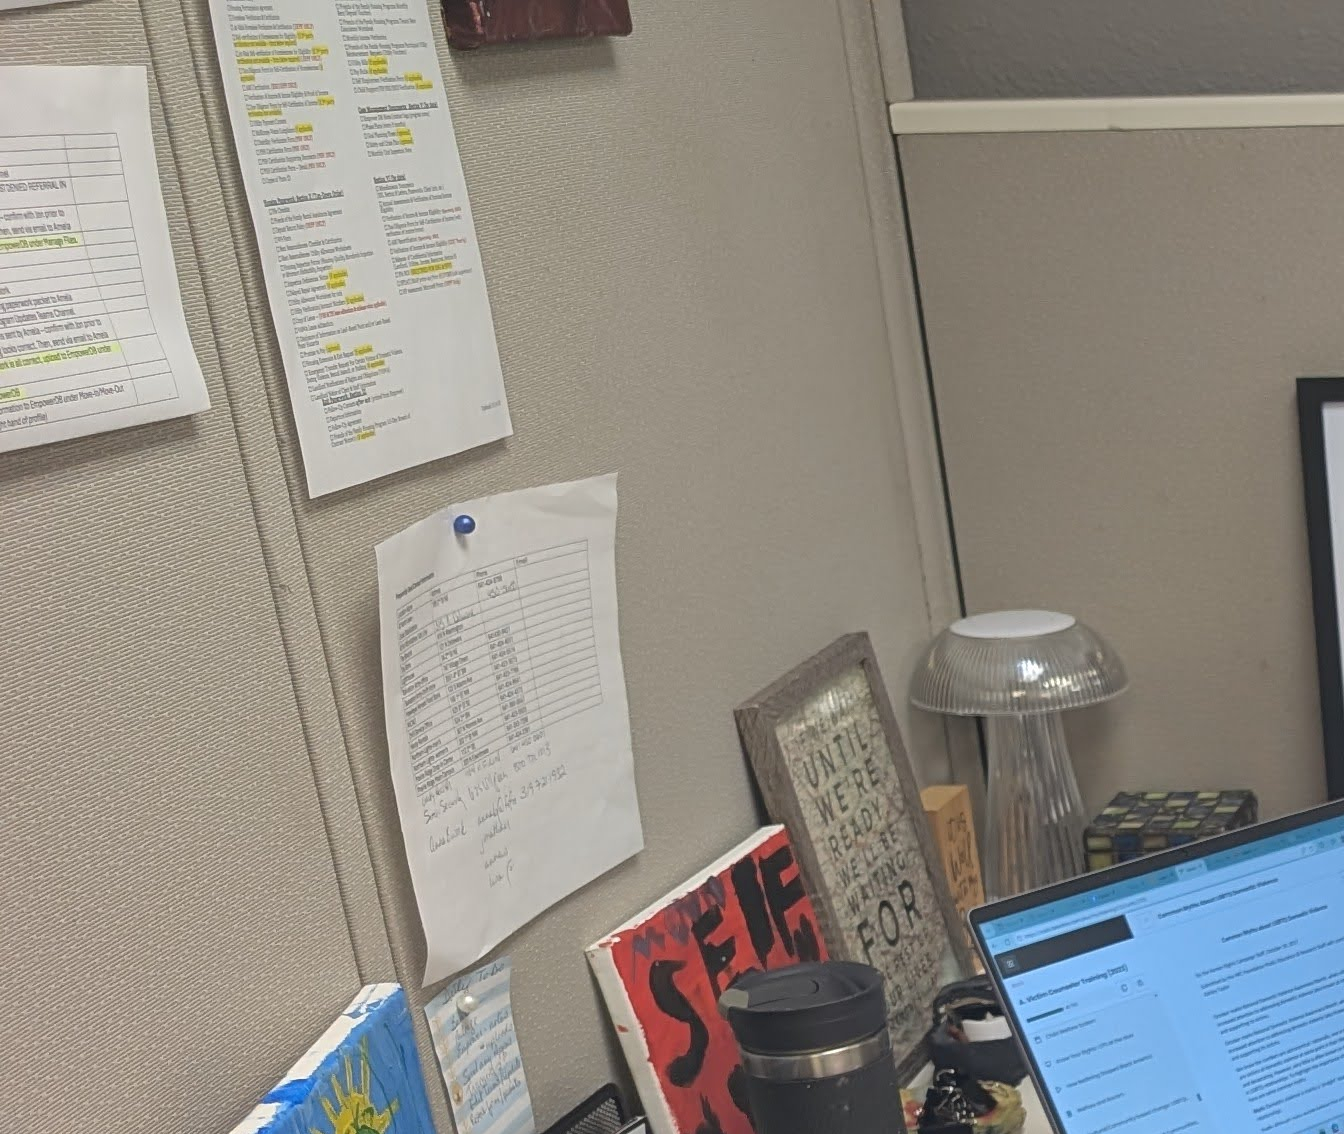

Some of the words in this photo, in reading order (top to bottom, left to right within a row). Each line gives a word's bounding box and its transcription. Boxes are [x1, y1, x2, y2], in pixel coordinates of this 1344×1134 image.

[802, 719, 868, 789] UNTIL
[815, 757, 880, 827] WE'RE
[828, 797, 883, 863] READY
[857, 879, 923, 969] FOR
[1025, 989, 1048, 1004] Victim
[1080, 971, 1108, 986] Training
